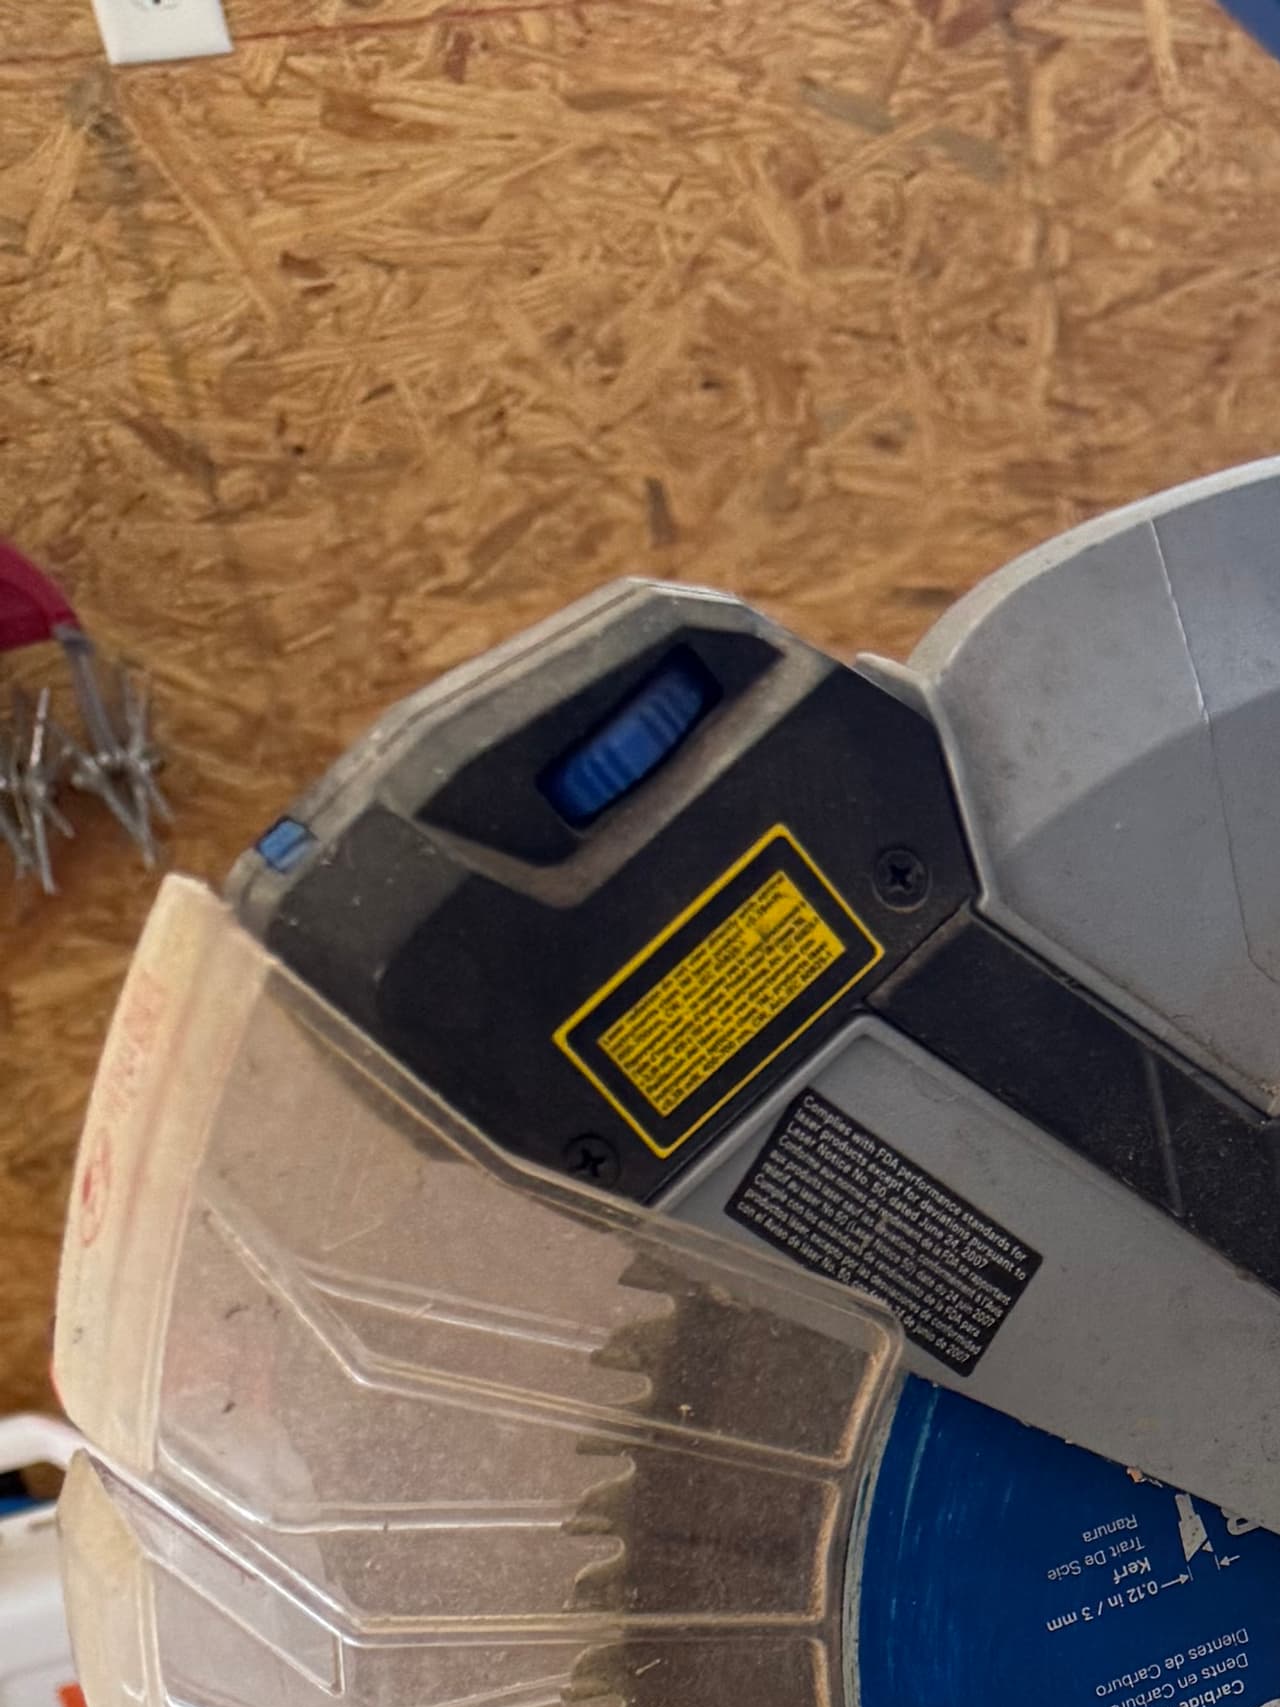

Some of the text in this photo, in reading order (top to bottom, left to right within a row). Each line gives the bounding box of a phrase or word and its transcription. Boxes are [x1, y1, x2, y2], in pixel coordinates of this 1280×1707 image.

[785, 1120, 988, 1270] Laser Notice dated June 2007
[800, 1094, 1027, 1262] Complies with FDA performance standards for
[818, 1127, 869, 1168] products
[865, 1161, 904, 1193] except
[902, 1185, 921, 1203] for
[918, 1198, 971, 1240] deviations
[967, 1236, 1015, 1275] pursuant
[1012, 1267, 1027, 1281] to
[1080, 1511, 1139, 1548] Ranura
[1044, 1534, 1145, 1586] Trait De Scie
[1108, 1555, 1152, 1585] Kerf
[1044, 1578, 1160, 1633] 0.12 in 3 mm
[1094, 1627, 1245, 1701] Dientes de Carburo
[1176, 1671, 1199, 1689] en
[1199, 1651, 1249, 1683] Dents
